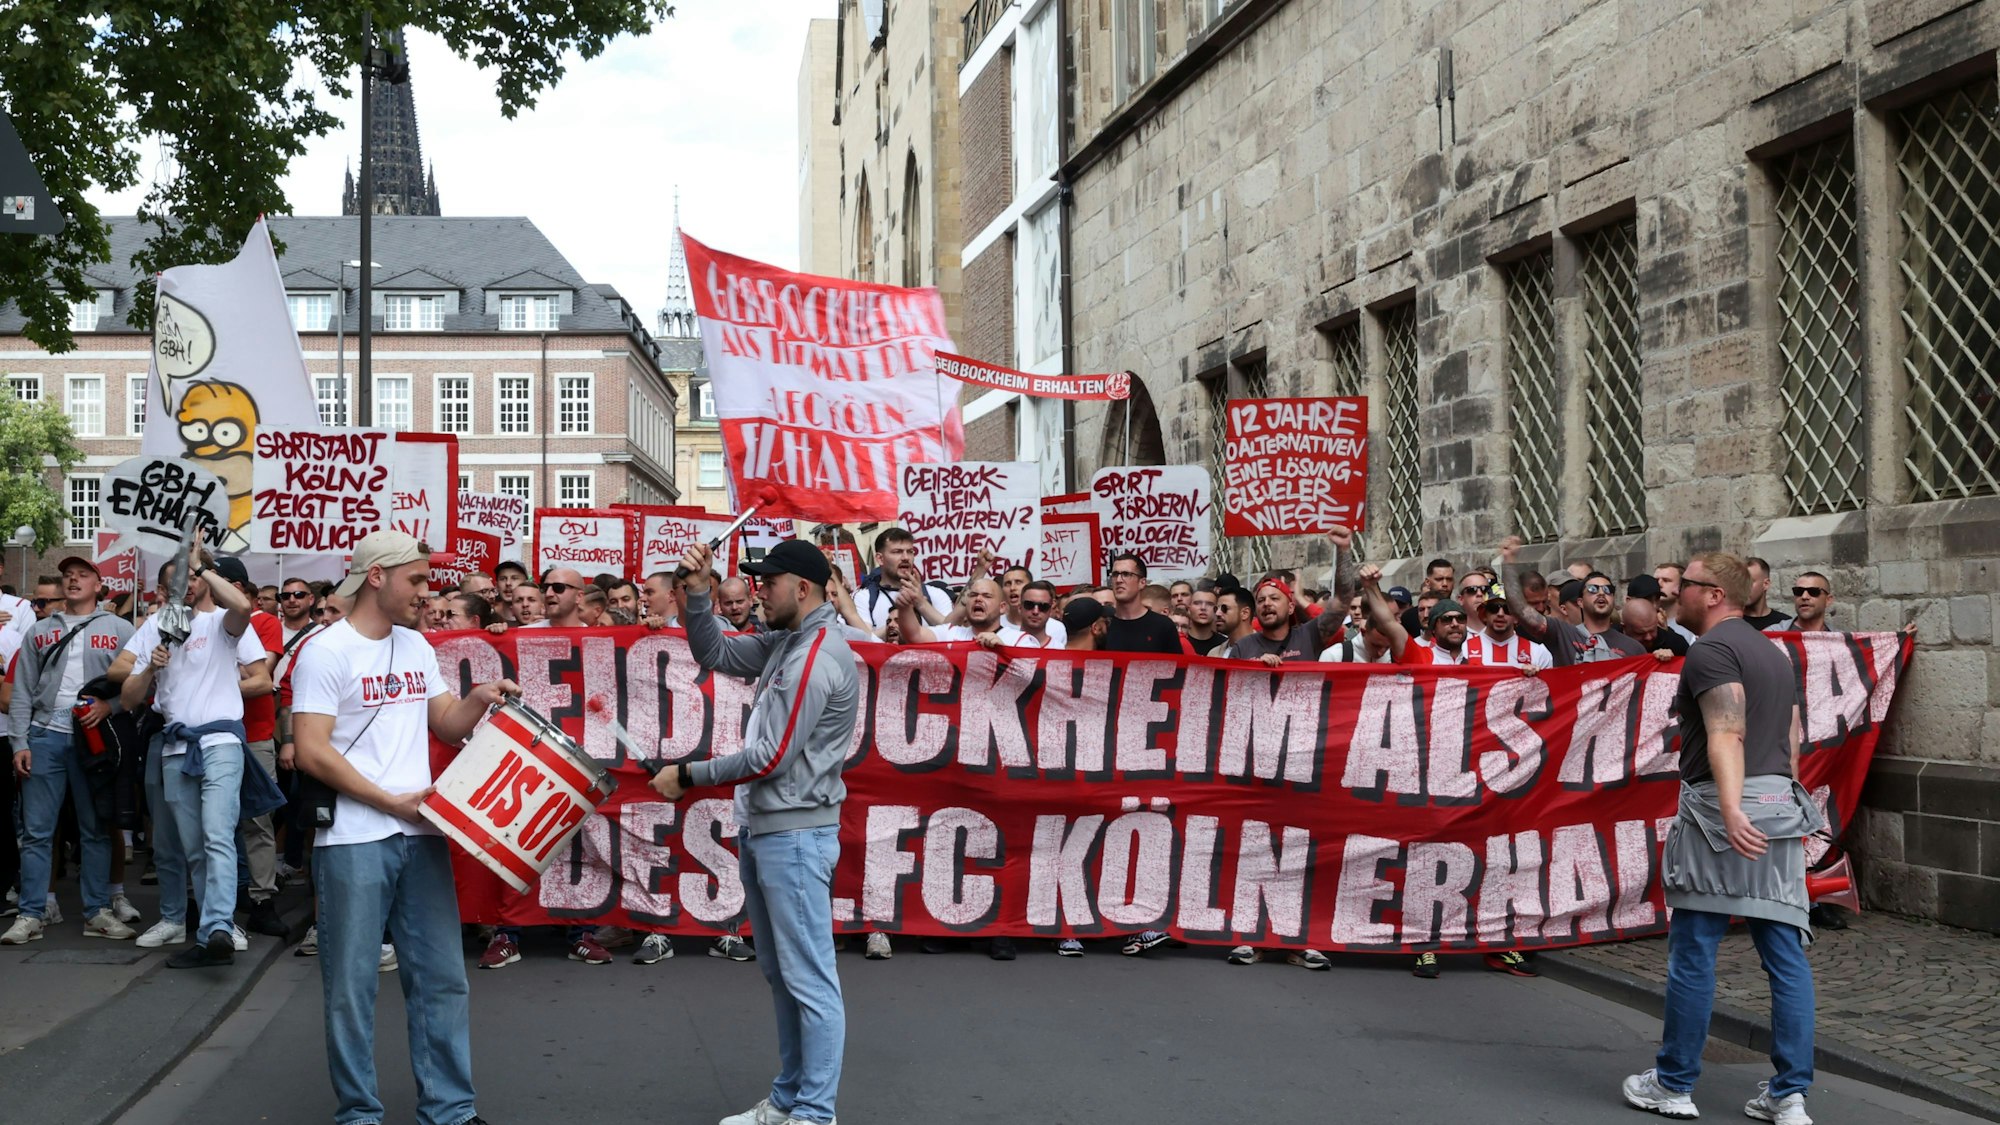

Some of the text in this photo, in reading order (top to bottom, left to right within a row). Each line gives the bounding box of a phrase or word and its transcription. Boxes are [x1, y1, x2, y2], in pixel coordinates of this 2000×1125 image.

[159, 337, 192, 365] GBH!
[935, 355, 1104, 394] GEIßBOCKHEIM ERHALTEN
[1231, 400, 1361, 437] 12 JAHRE
[256, 431, 387, 465] SPORTSTADT
[1239, 432, 1366, 460] ALTERNATIVEN
[141, 460, 216, 506] GBH
[904, 465, 1008, 497] GEIßBOCK-
[1225, 458, 1272, 486] EINE
[254, 488, 380, 522] ZEIGT ES
[930, 486, 992, 514] HEIM
[1112, 489, 1199, 522] FÖRDERN
[1225, 477, 1338, 514] GLEUELER
[559, 519, 598, 536] CDU
[658, 520, 701, 541] GBH
[899, 506, 1034, 534] BLOCKIEREN?
[1242, 501, 1364, 531] WIESE!
[542, 545, 625, 566] DÜSSELDORFER
[34, 629, 118, 650] ULT RAS
[404, 671, 427, 695] RAS
[1341, 674, 1549, 798] ALS
[1557, 631, 1900, 783] HEAT
[539, 798, 746, 922] DES
[1026, 797, 1310, 938] KÖLN
